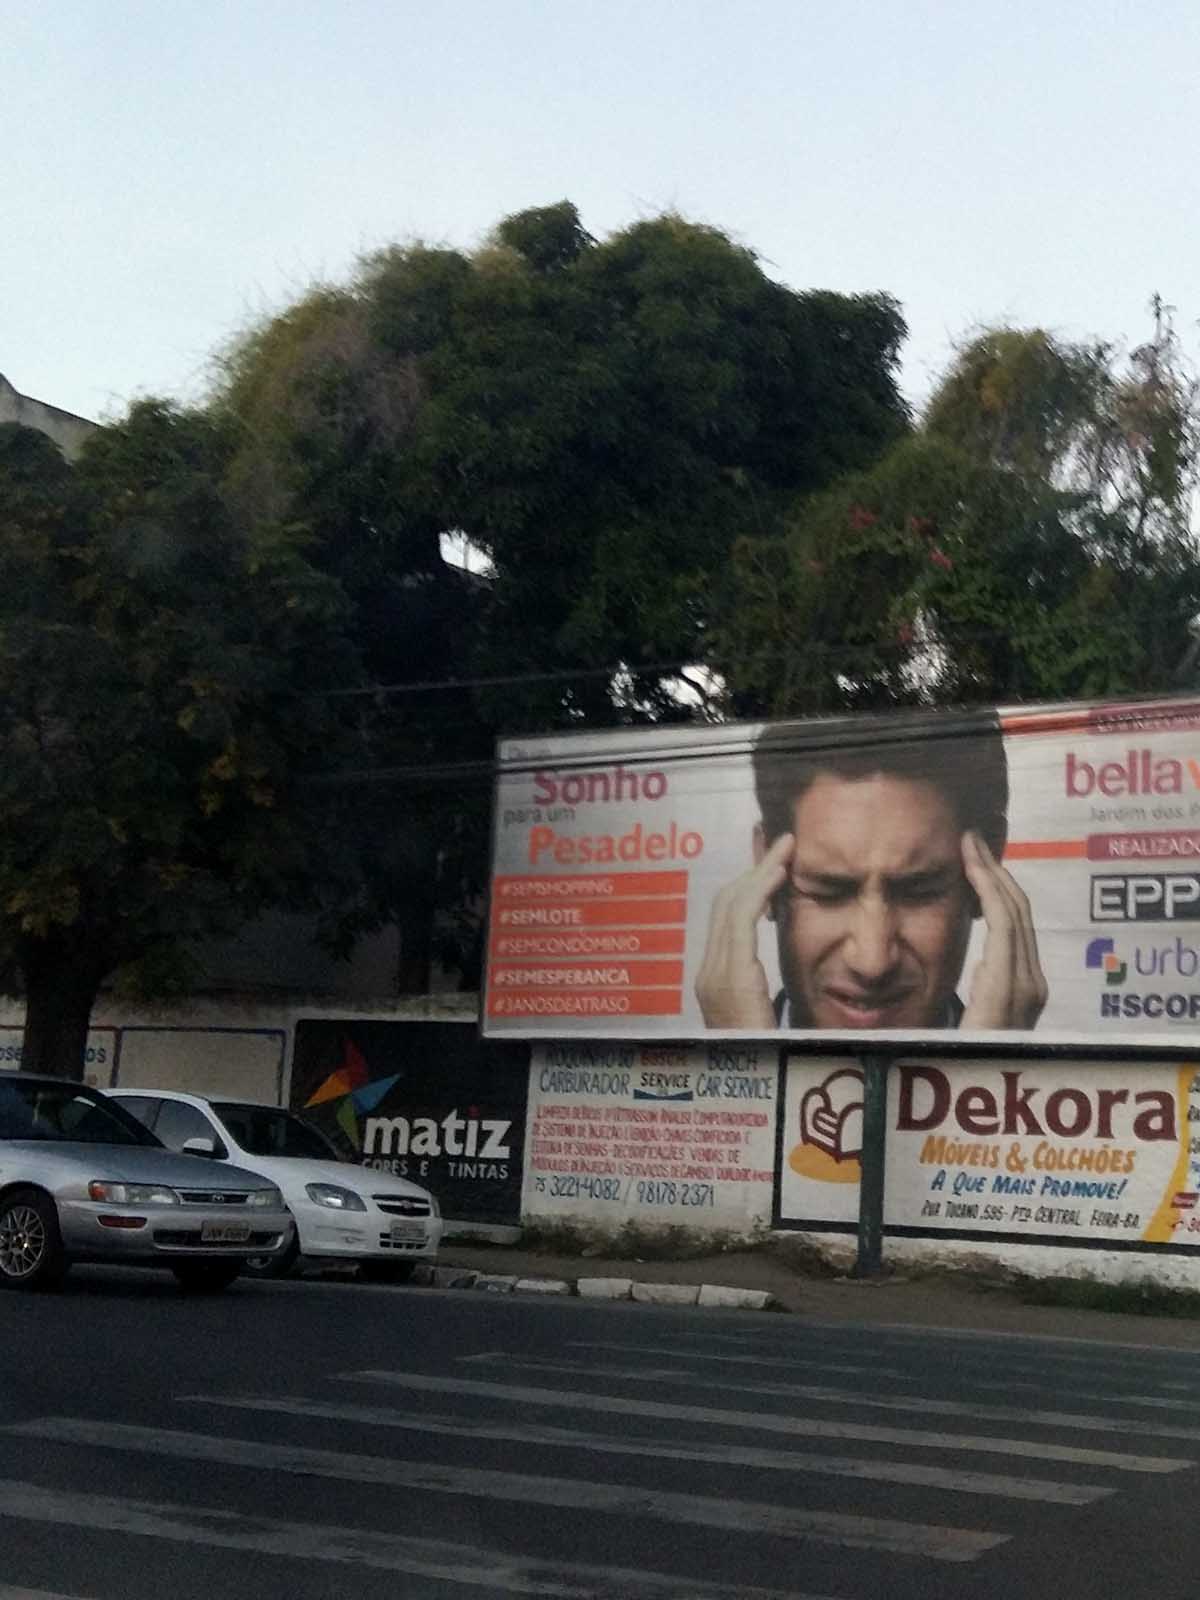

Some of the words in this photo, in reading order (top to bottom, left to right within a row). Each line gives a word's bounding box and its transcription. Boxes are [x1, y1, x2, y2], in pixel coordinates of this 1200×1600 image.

[533, 762, 668, 806] Sonho
[1065, 749, 1183, 798] bella
[529, 819, 704, 866] Pesadelo
[1092, 876, 1200, 920] EPP
[500, 907, 583, 927] #SEMLOTE
[540, 1068, 631, 1096] CARBURADOR
[640, 1072, 691, 1089] SERVICE
[696, 1073, 722, 1098] CAR
[724, 1075, 773, 1100] SERVICE
[896, 1065, 1178, 1142] Dekora
[363, 1105, 513, 1160] matiz
[419, 1161, 430, 1177] E
[447, 1162, 509, 1181] TINTAS
[1004, 1142, 1030, 1174] &
[1032, 1141, 1137, 1175] COLCHÕES
[549, 1175, 621, 1201] 3221-4082
[930, 1169, 946, 1192] A
[952, 1172, 987, 1196] QUE
[991, 1175, 1035, 1197] MAIS
[1039, 1176, 1129, 1201] PROMOVE!
[1034, 1205, 1082, 1227] CENTRAL
